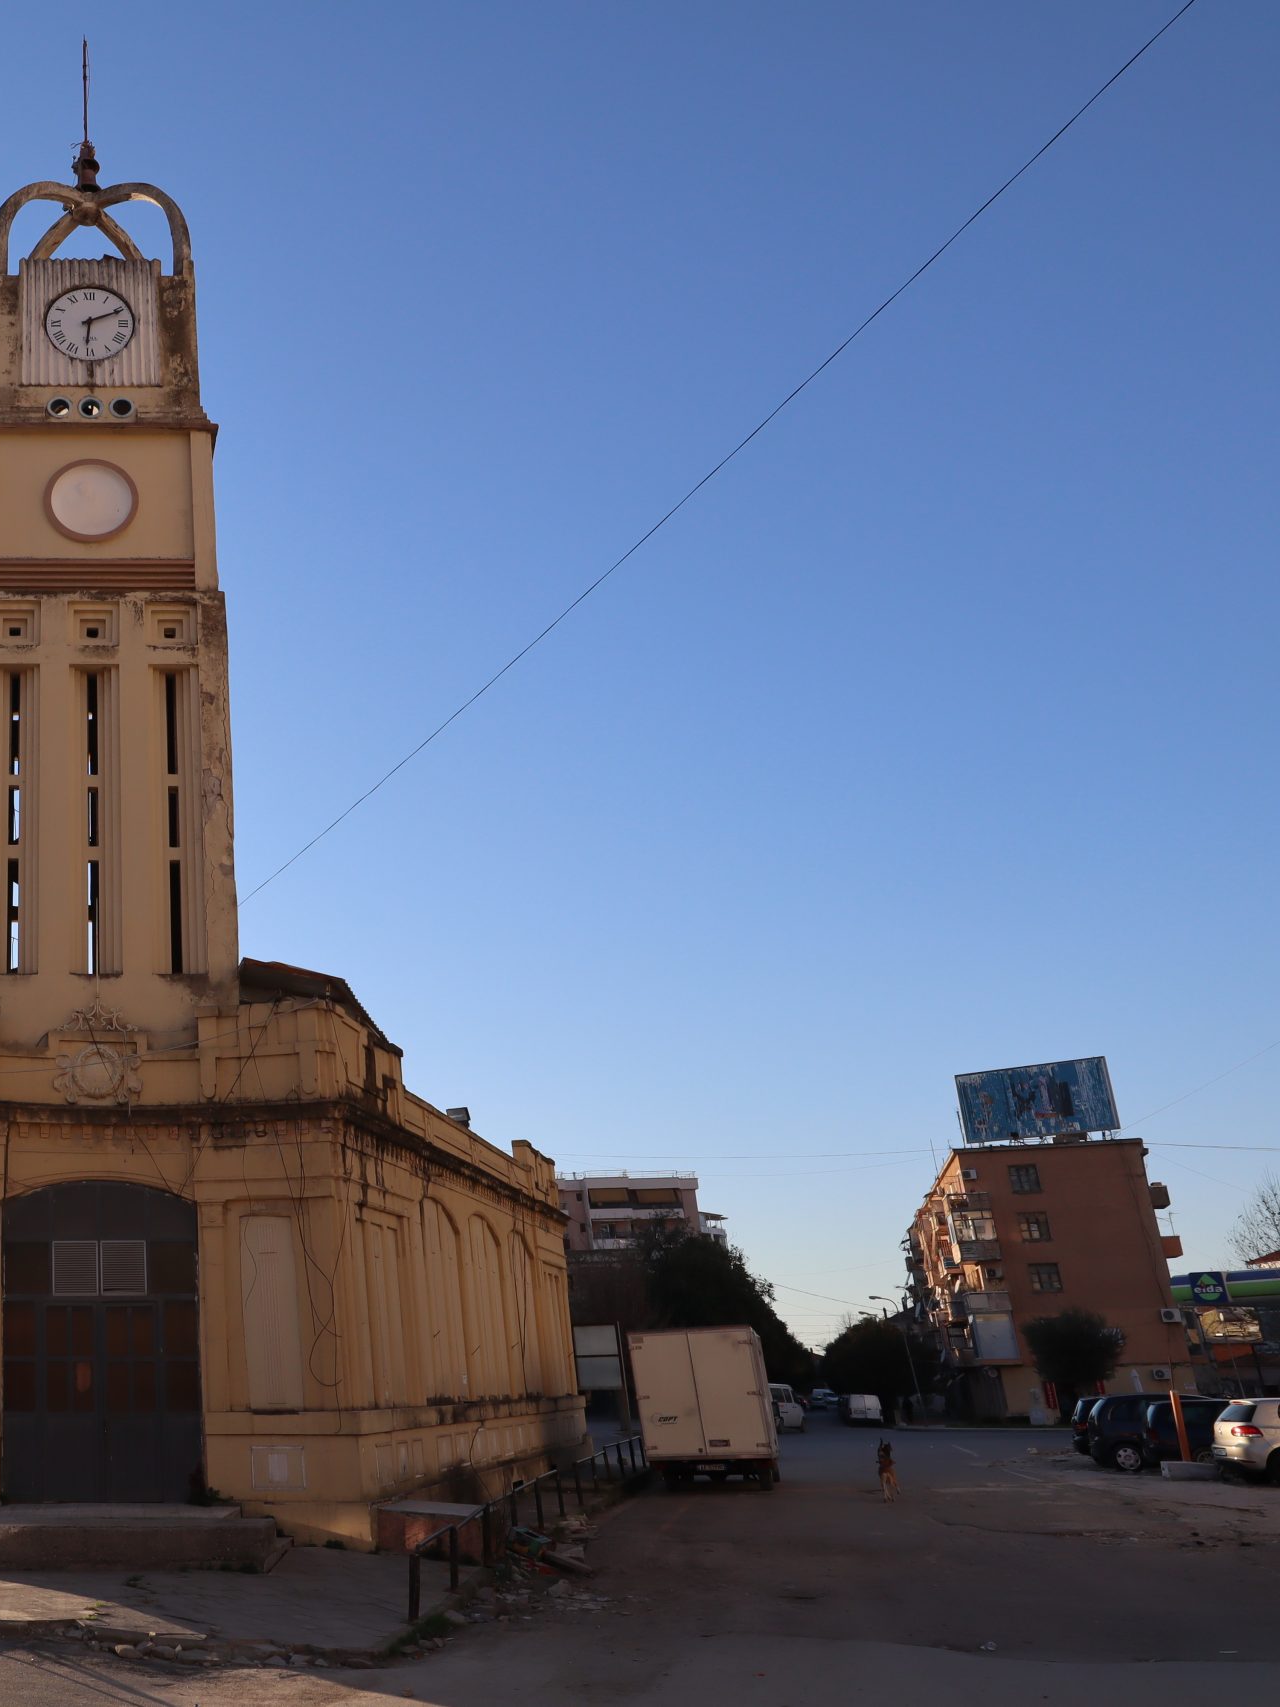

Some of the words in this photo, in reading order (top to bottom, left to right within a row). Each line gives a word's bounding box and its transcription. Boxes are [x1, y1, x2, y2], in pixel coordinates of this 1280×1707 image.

[67, 295, 78, 304] XI
[83, 292, 95, 301] XII
[103, 296, 109, 304] I
[52, 330, 66, 345] VIII
[66, 342, 78, 354] VII
[86, 347, 95, 357] VI
